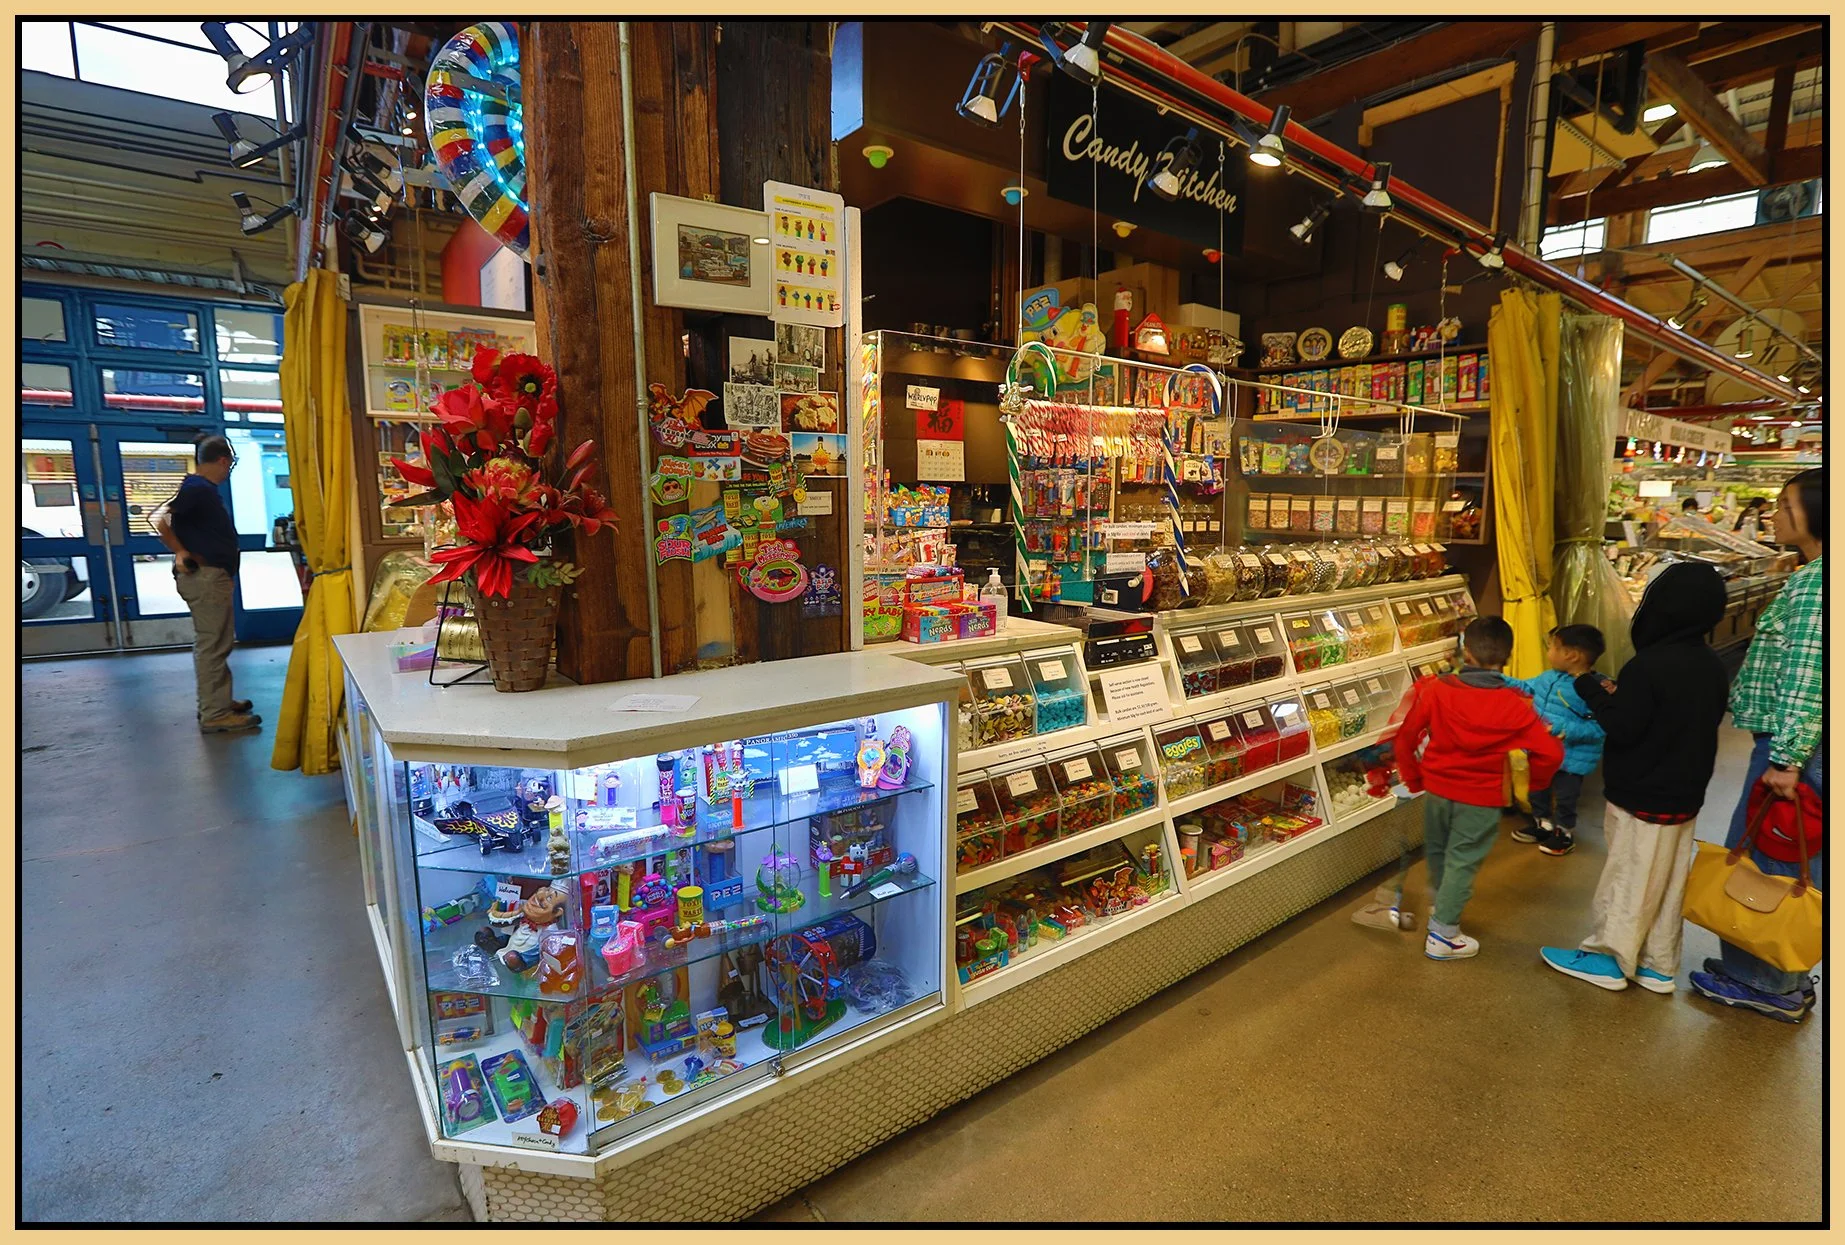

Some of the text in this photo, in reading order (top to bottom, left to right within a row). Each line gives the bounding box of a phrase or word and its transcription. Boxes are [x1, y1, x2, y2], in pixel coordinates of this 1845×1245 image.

[1063, 114, 1237, 214] Candy itchen
[1025, 295, 1051, 318] PEZ
[657, 539, 692, 550] SOUR
[878, 606, 903, 617] BABY
[746, 735, 788, 745] PANORAMIC
[1165, 738, 1199, 758] eggies
[499, 886, 519, 895] Welcome
[710, 885, 742, 901] PEZ
[439, 998, 480, 1012] PEZ
